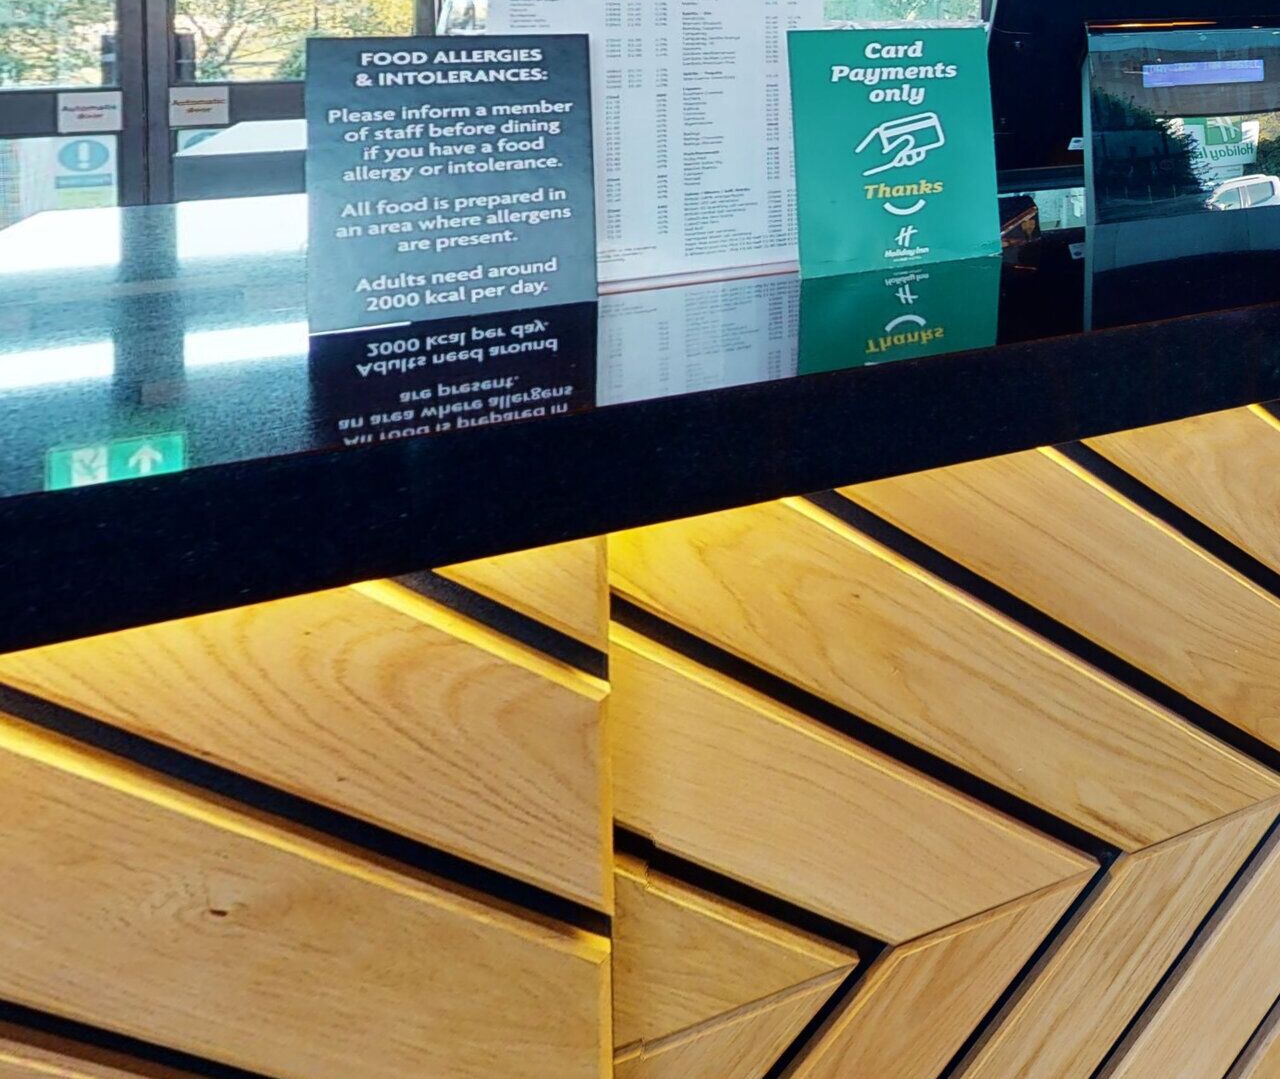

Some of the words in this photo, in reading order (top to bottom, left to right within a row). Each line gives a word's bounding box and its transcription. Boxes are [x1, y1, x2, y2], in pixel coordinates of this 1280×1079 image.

[361, 51, 428, 66] FOOD
[433, 48, 543, 64] ALLERGIES
[865, 40, 923, 59] Card
[355, 72, 373, 87] &
[379, 67, 549, 86] INTOLERANCES:
[831, 61, 957, 85] Payments
[869, 84, 925, 105] only
[328, 108, 395, 123] Please
[401, 104, 470, 120] inform
[475, 106, 488, 117] a
[492, 99, 573, 115] member
[344, 126, 369, 142] of
[374, 123, 423, 140] staff
[428, 120, 495, 137] before
[501, 119, 561, 135] dining
[364, 147, 379, 161] if
[384, 147, 423, 163] you
[428, 142, 476, 157] have
[481, 144, 493, 154] a
[497, 137, 545, 152] food
[343, 165, 414, 182] allergy
[420, 164, 442, 176] or
[448, 157, 563, 174] intolerance.
[864, 179, 944, 199] Thanks
[341, 200, 371, 218] All
[376, 197, 428, 215] food
[434, 196, 449, 210] is
[454, 188, 544, 212] prepared
[549, 188, 567, 201] in
[336, 224, 362, 238] an
[368, 222, 413, 236] area
[418, 215, 481, 231] where
[486, 207, 572, 226] allergens
[398, 239, 430, 252] are
[435, 230, 519, 252] present.
[355, 273, 426, 293] Adults
[432, 265, 483, 285] need
[488, 257, 559, 277] around
[366, 292, 420, 312] 2000
[425, 286, 465, 305] kcal
[471, 285, 506, 303] per
[510, 280, 549, 298] day.
